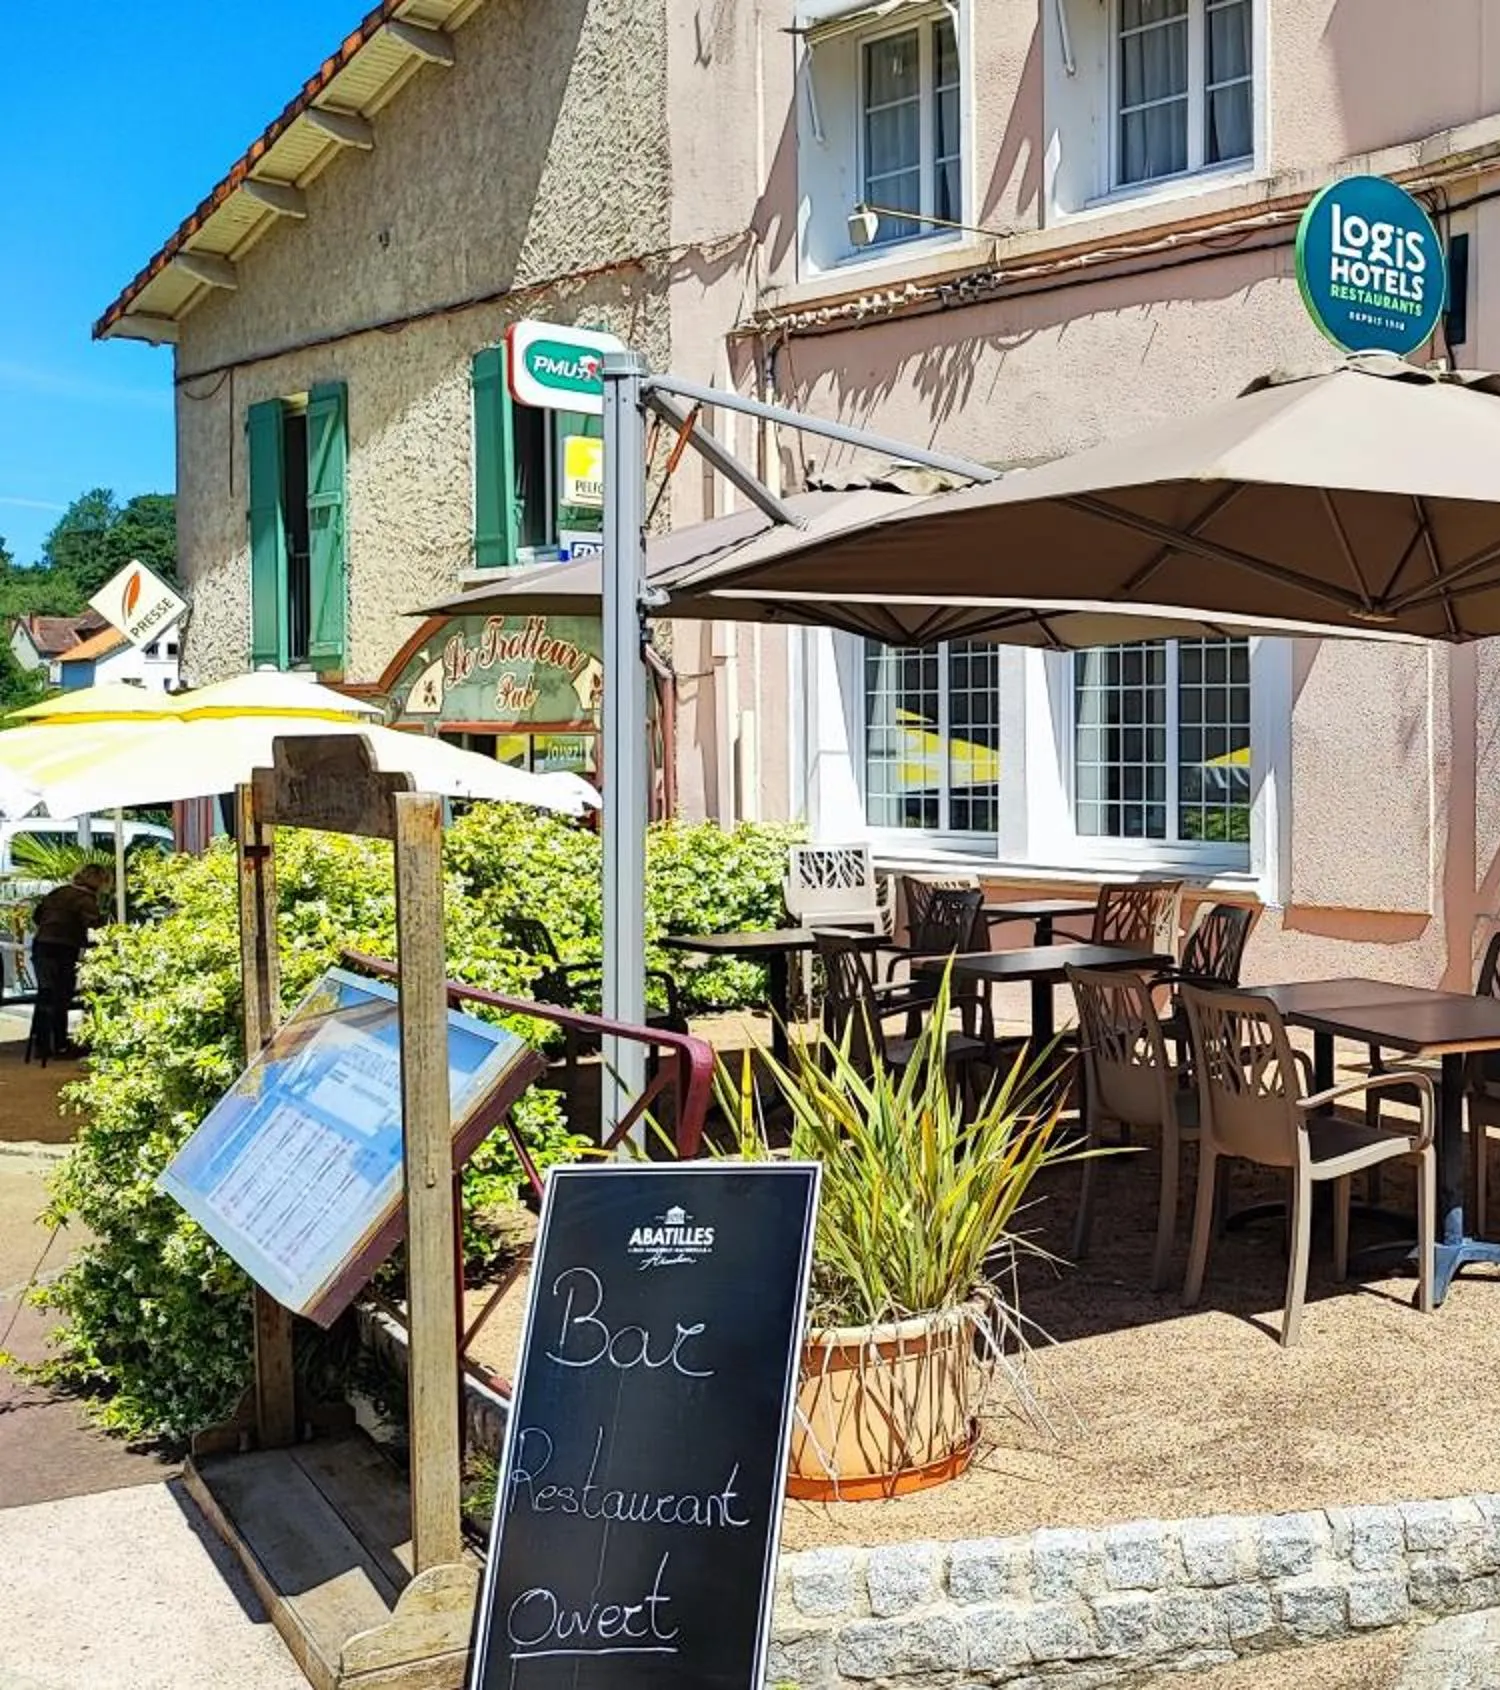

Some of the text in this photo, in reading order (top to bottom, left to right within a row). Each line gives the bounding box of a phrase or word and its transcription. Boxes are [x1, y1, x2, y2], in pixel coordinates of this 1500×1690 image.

[1331, 256, 1425, 301] HOTELS
[1330, 284, 1423, 317] RESTAURANTS
[533, 355, 577, 377] PMU
[130, 597, 174, 638] PRESSE
[478, 615, 589, 673] Trotteur
[496, 671, 540, 711] Pub
[628, 1227, 715, 1246] ABATILLES
[545, 1267, 715, 1377] Bar
[509, 1426, 750, 1527] Restaurant
[507, 1551, 679, 1645] Ouvert
